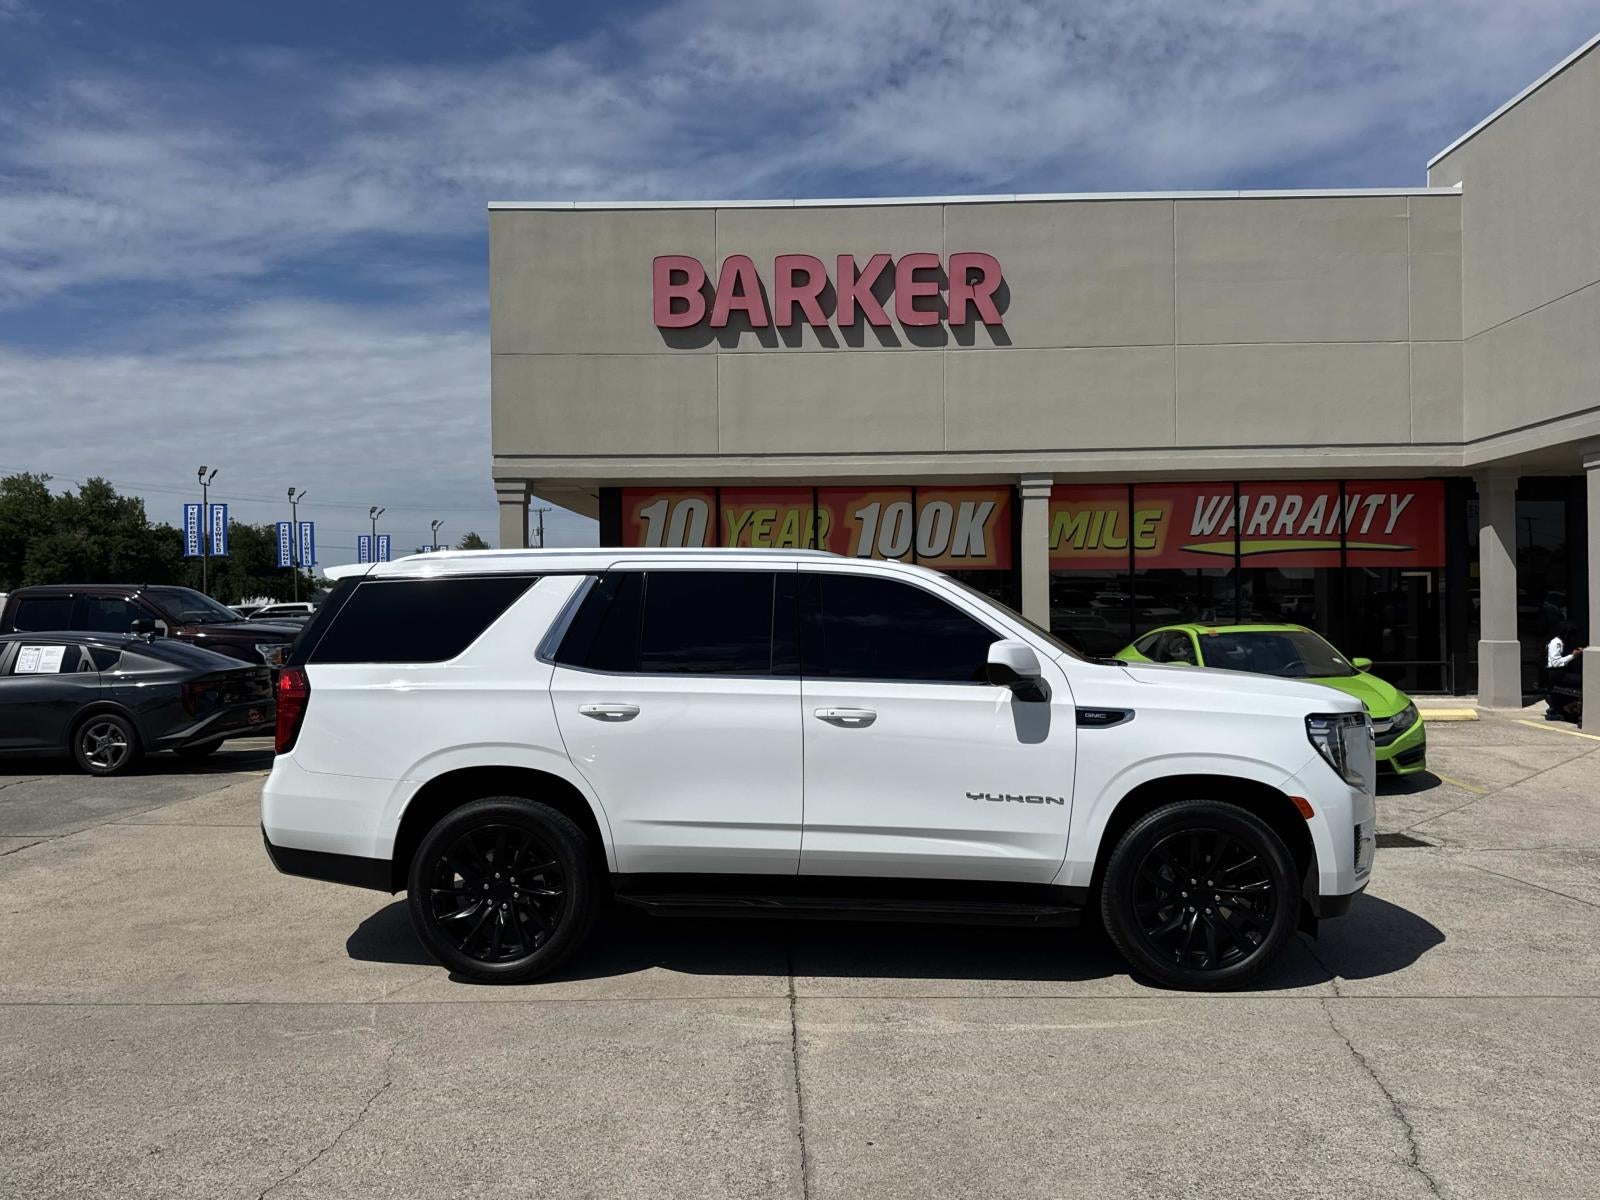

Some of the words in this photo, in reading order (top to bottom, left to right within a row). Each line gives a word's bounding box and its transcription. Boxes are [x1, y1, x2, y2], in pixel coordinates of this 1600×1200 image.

[653, 253, 1003, 328] BARKER
[638, 498, 710, 548] 10
[725, 509, 830, 550] YEAR
[854, 501, 996, 559] 100K
[1050, 510, 1163, 549] MILE
[1189, 492, 1415, 536] WARRANTY
[966, 792, 1064, 805] YUKON
